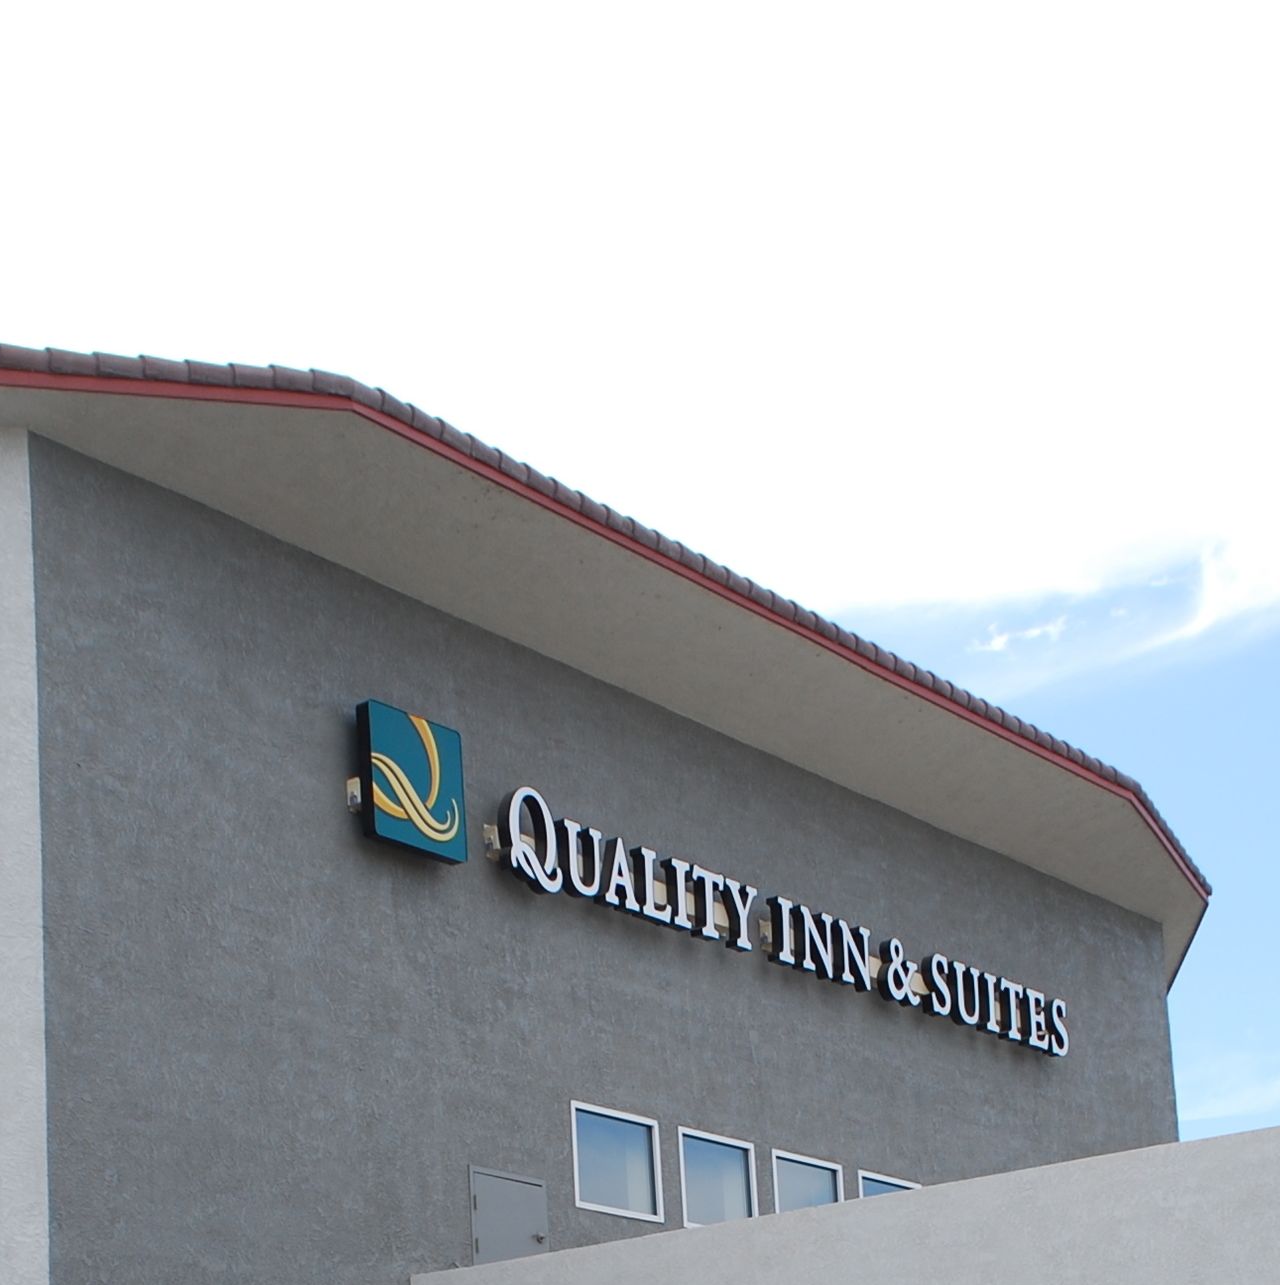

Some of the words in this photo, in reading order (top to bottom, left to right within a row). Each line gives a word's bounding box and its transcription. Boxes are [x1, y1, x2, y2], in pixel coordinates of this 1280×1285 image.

[506, 786, 757, 951] QUALITY
[775, 896, 871, 992] INN
[885, 938, 920, 1007] &
[928, 953, 1070, 1057] SUITES
